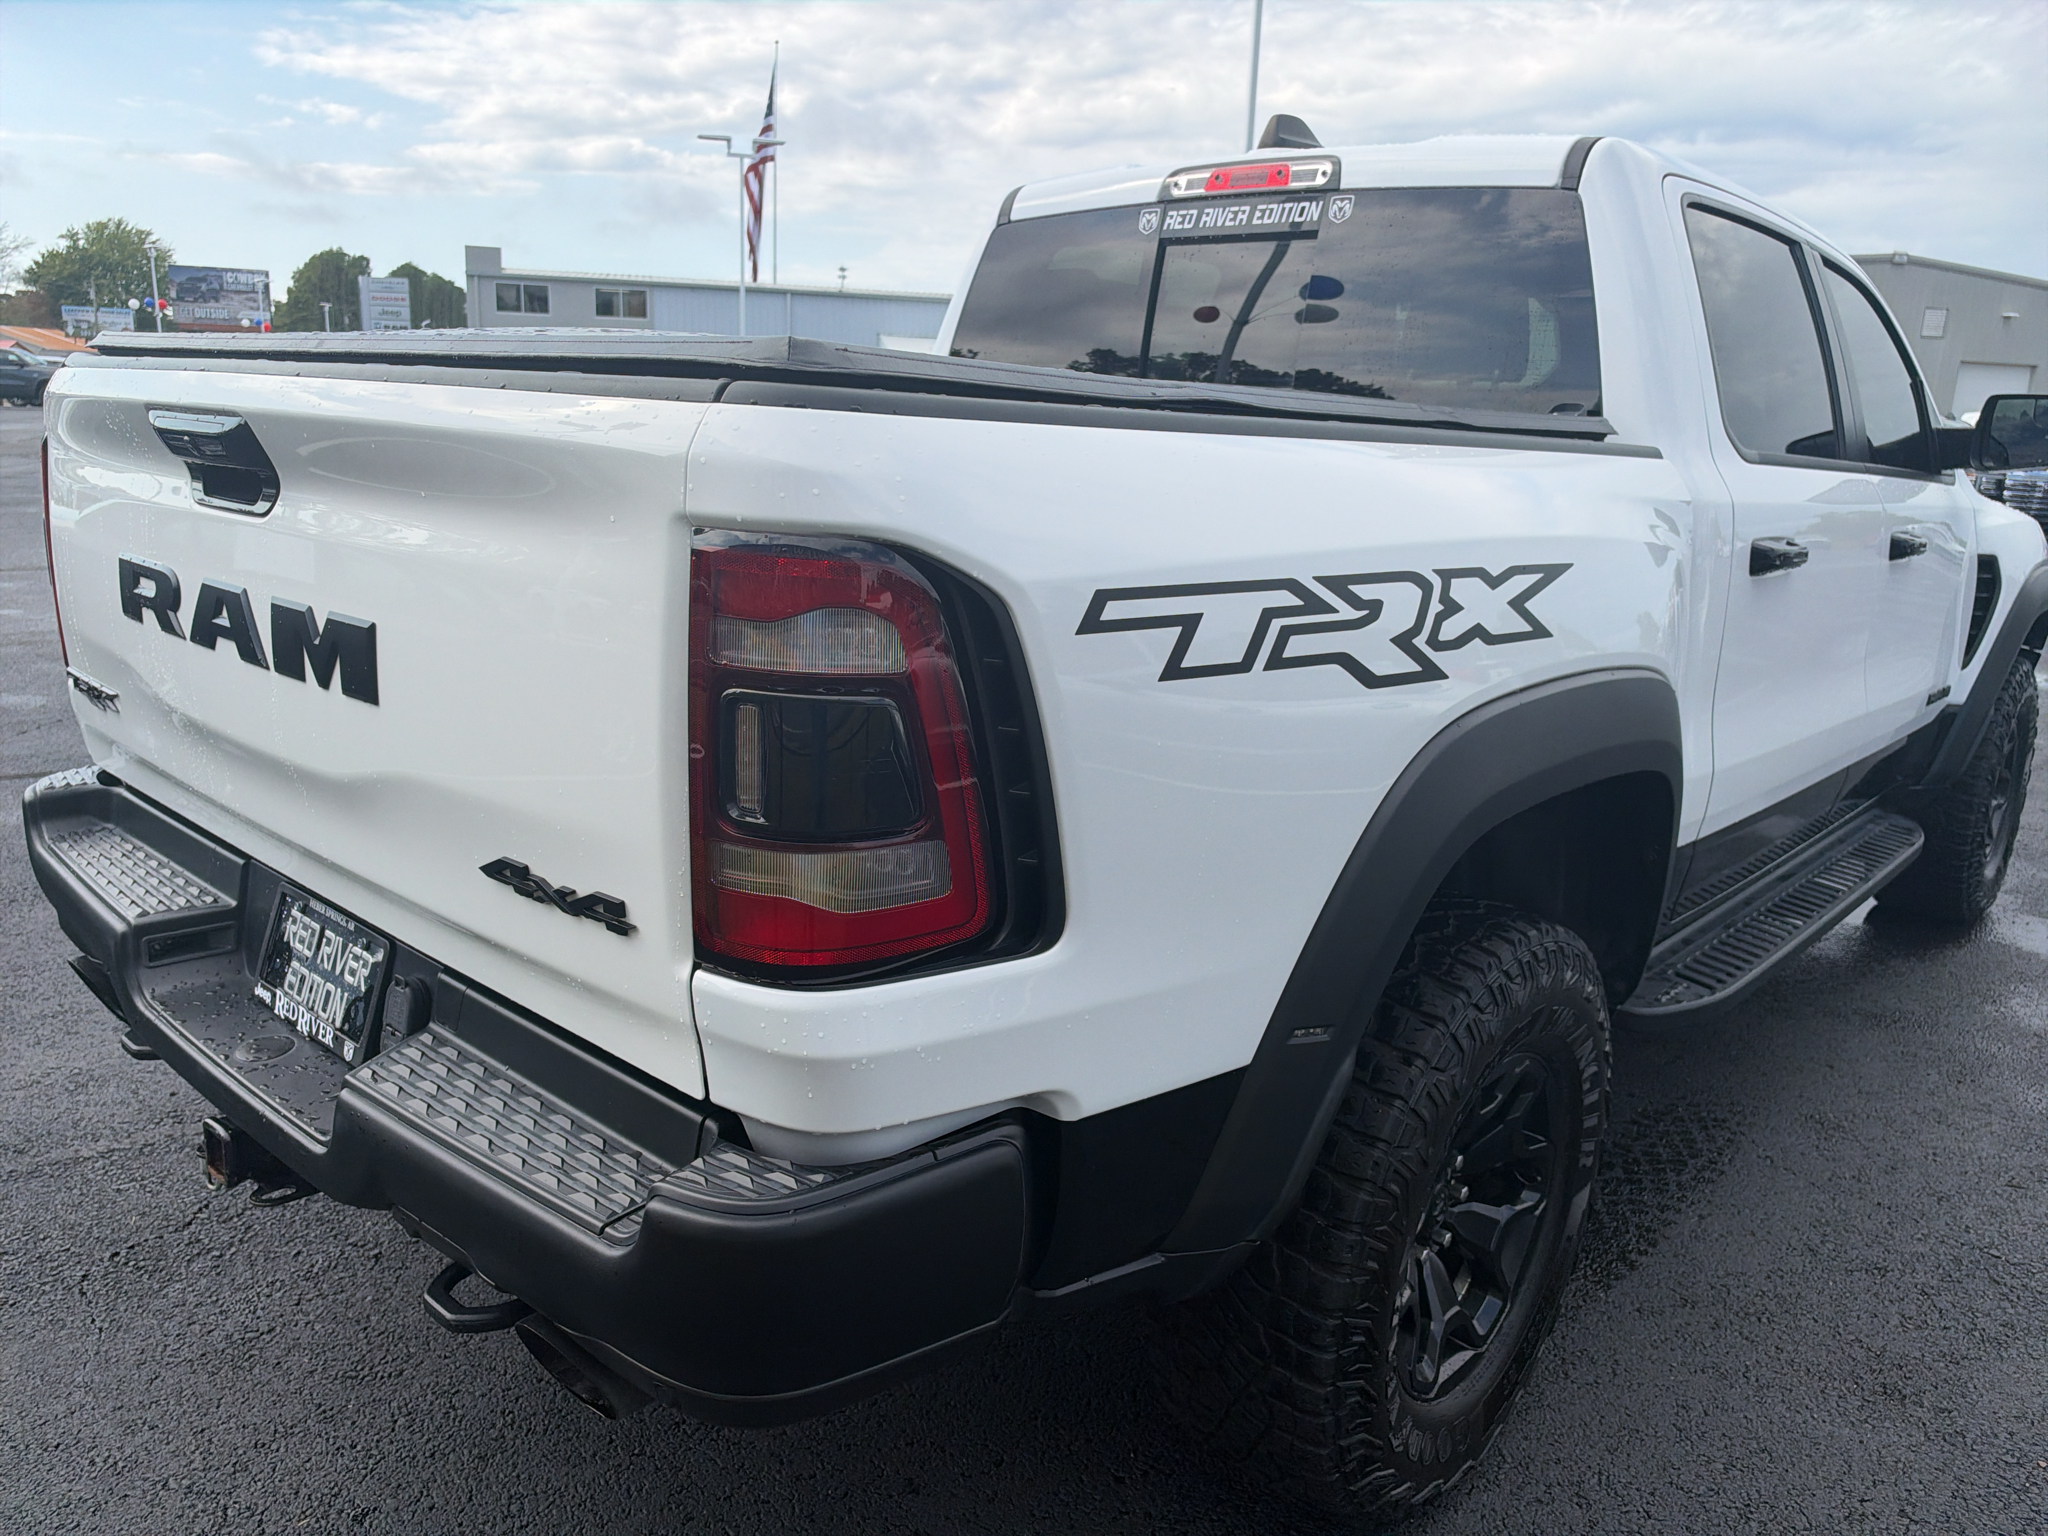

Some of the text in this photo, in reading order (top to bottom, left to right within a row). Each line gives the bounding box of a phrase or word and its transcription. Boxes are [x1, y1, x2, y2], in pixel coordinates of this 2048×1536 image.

[1163, 201, 1324, 231] RED RIVER EDITION
[180, 307, 193, 319] GET
[194, 308, 230, 320] OUTSIDE
[378, 308, 403, 318] Jeep
[118, 551, 380, 706] RAM
[1075, 563, 1574, 690] TRX
[283, 909, 373, 993] RED RIVER
[254, 982, 272, 1005] Jeep
[283, 960, 348, 1029] EDITION
